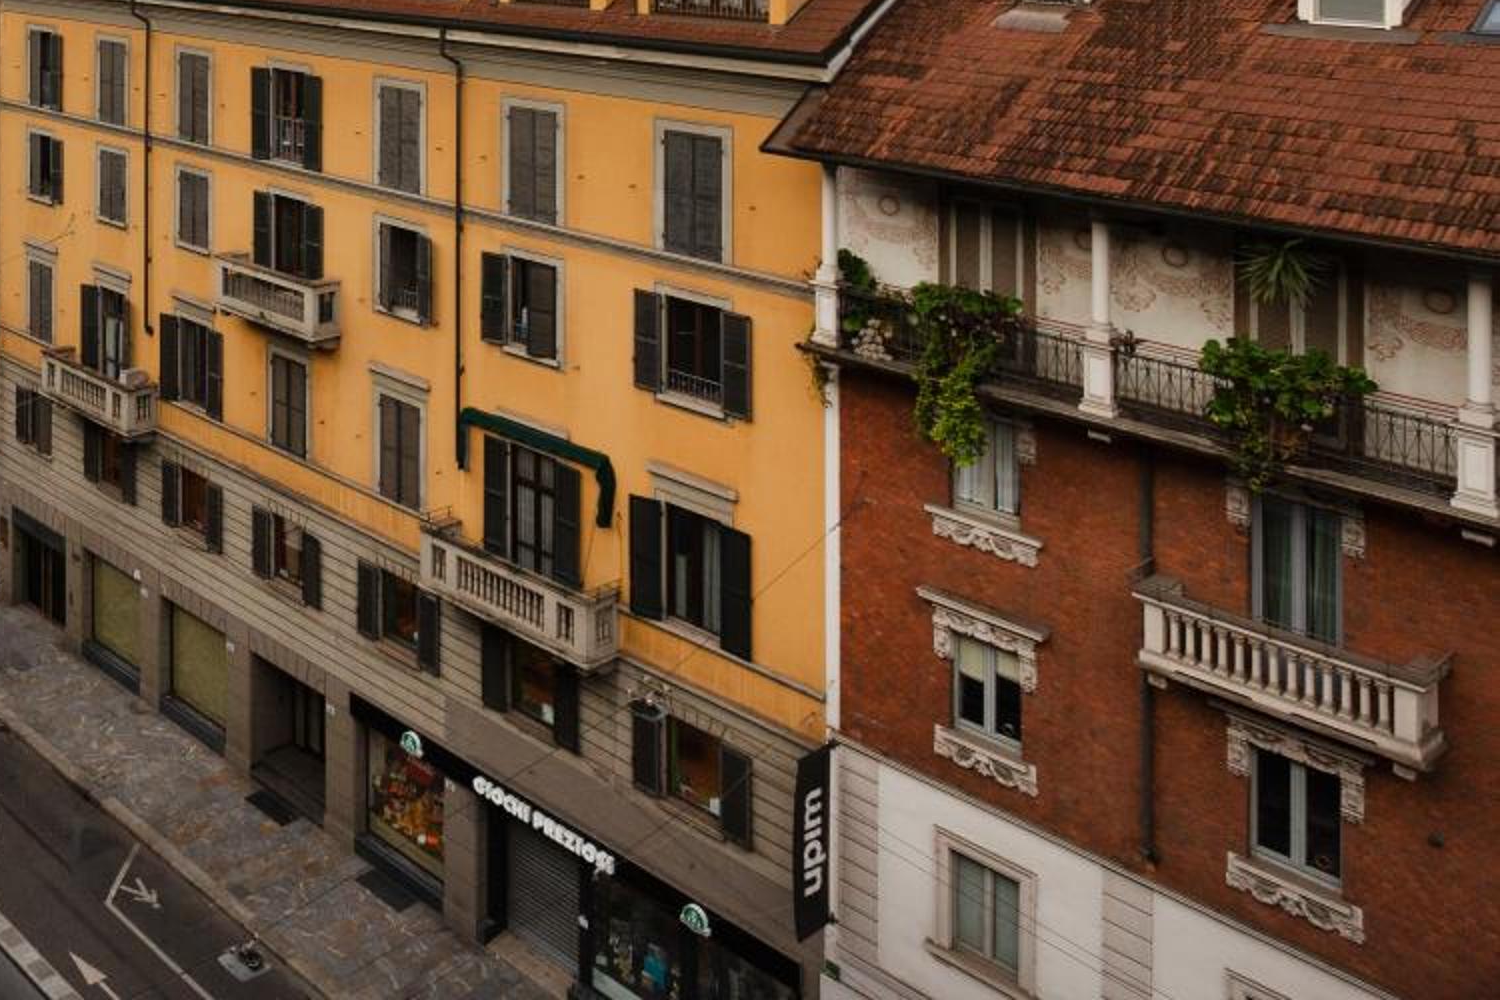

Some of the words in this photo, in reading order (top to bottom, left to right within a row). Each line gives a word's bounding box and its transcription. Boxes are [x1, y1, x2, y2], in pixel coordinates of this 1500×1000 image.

[473, 776, 531, 823] GIOCHI
[532, 811, 615, 875] PREZIOSI
[804, 787, 827, 897] upim
